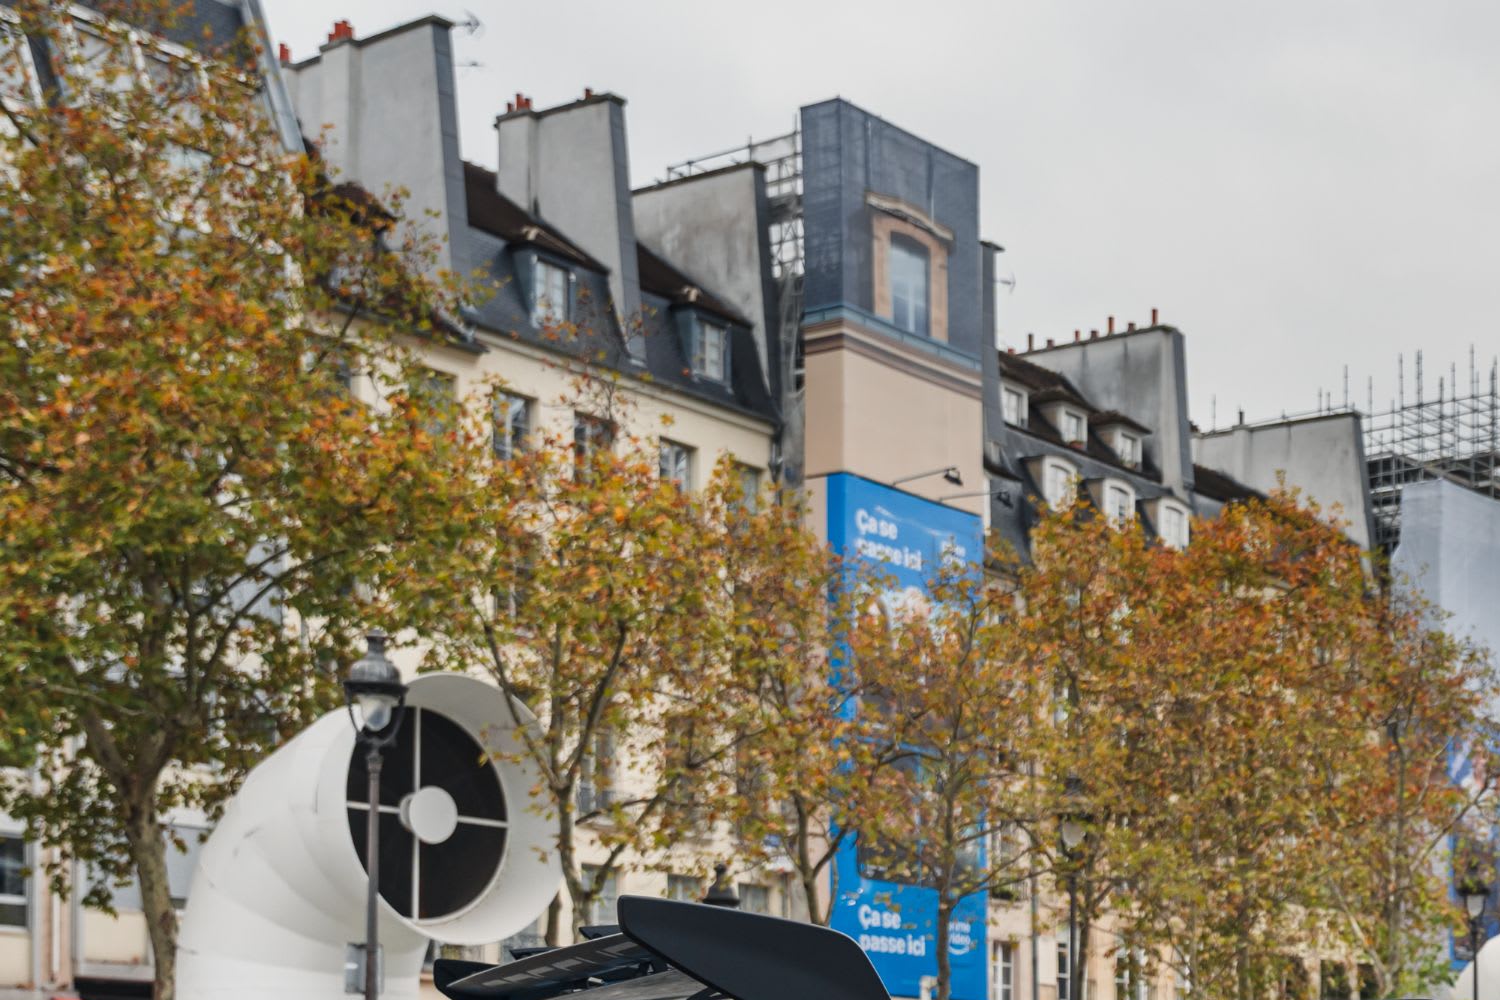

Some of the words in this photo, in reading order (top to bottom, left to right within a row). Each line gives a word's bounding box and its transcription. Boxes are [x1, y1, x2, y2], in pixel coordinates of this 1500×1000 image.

[855, 508, 878, 535] Ça
[879, 520, 898, 540] se
[858, 904, 881, 930] Ça
[882, 911, 901, 930] se
[859, 934, 906, 955] passe
[907, 934, 926, 957] ici
